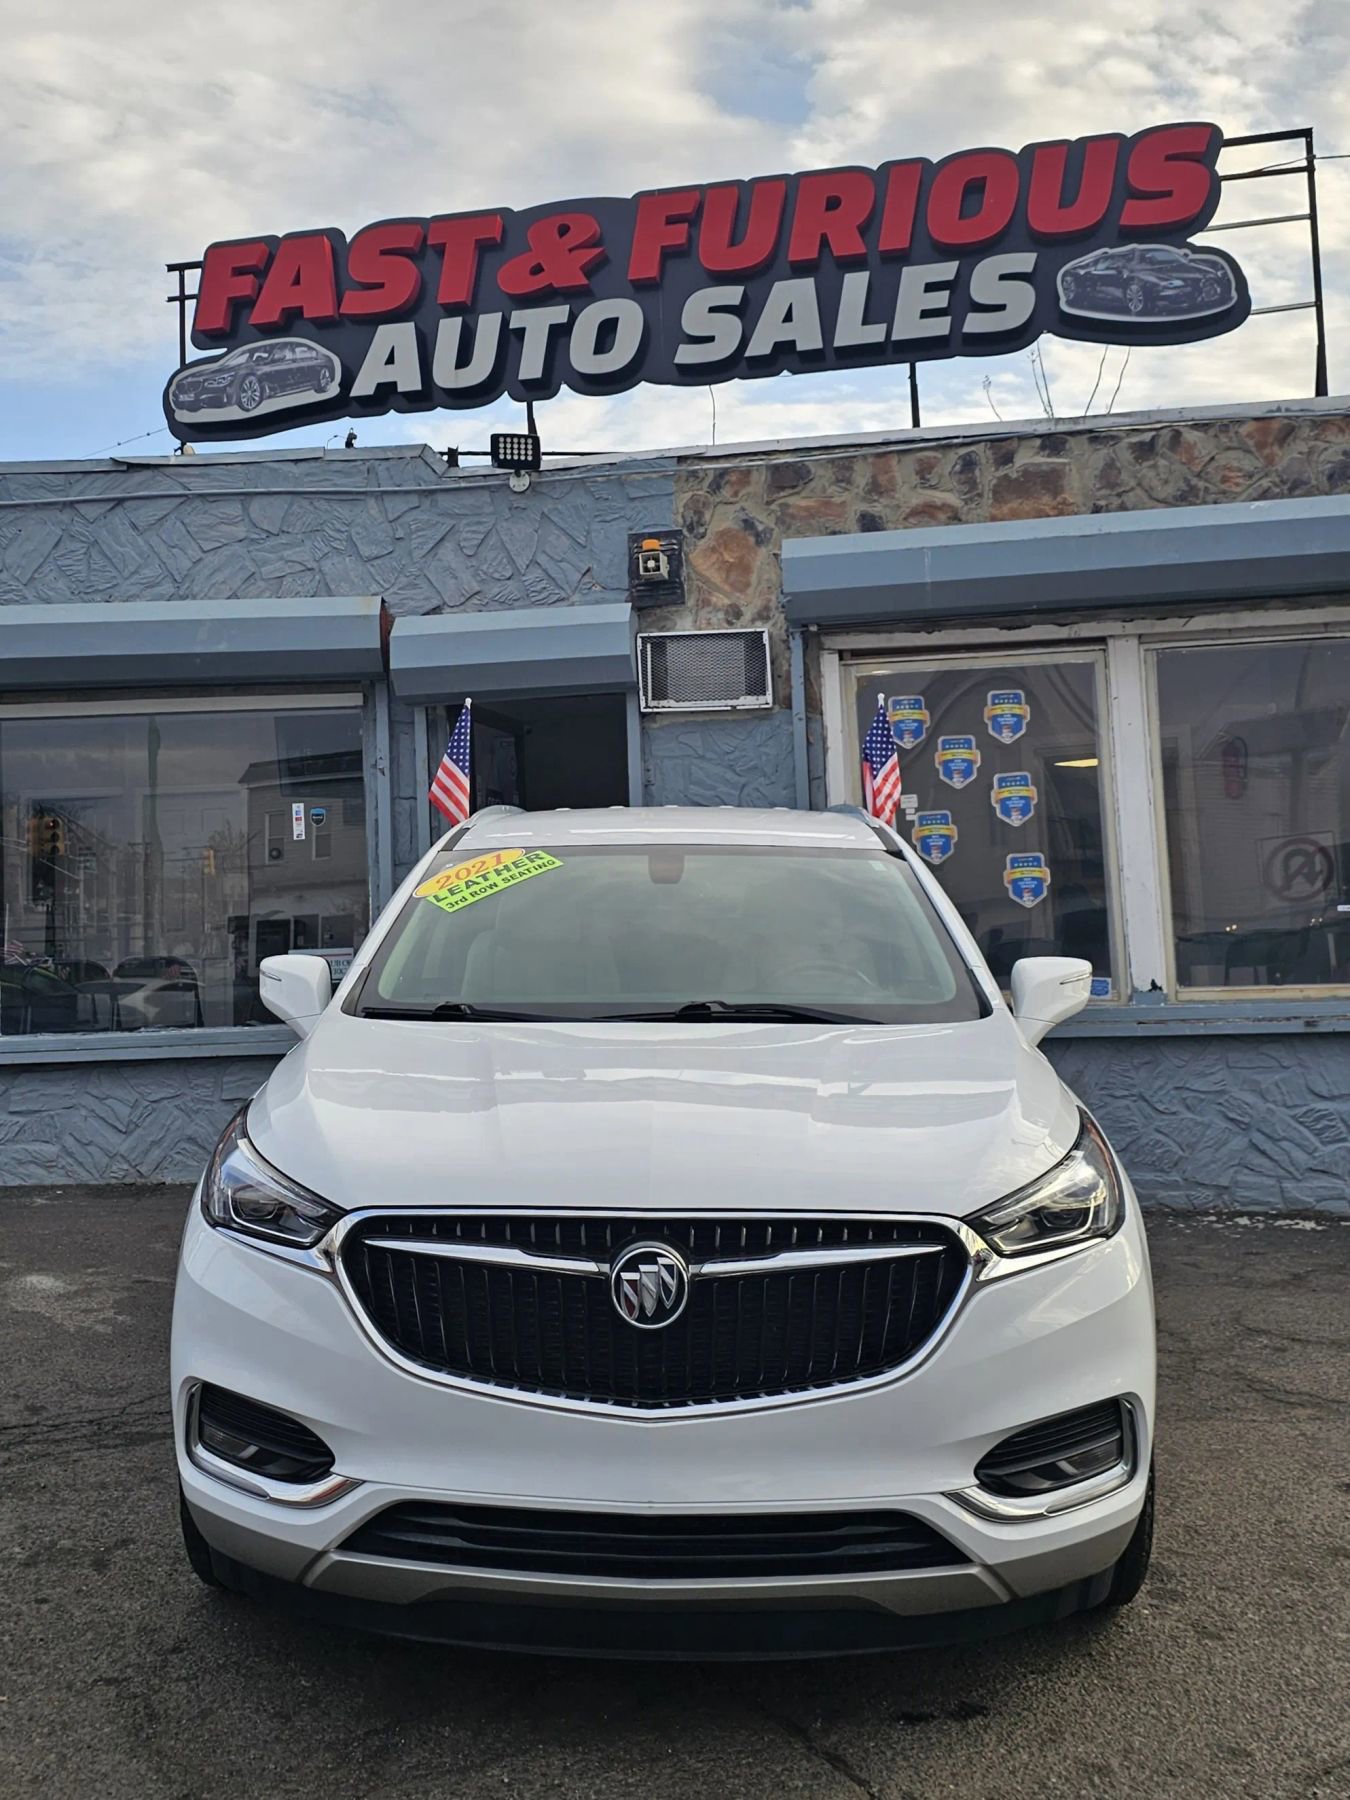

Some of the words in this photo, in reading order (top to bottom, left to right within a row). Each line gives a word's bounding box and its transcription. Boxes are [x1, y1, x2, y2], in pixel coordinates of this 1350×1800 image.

[194, 214, 503, 333] FAST
[496, 212, 606, 297] &
[627, 124, 1219, 288] FURIOUS
[349, 298, 645, 398] AUTO
[673, 251, 1038, 367] SALES
[432, 852, 546, 904] LEATHER
[435, 853, 505, 891] 2021
[445, 895, 469, 910] 3rd
[470, 882, 499, 898] ROW
[501, 859, 557, 885] SEATING
